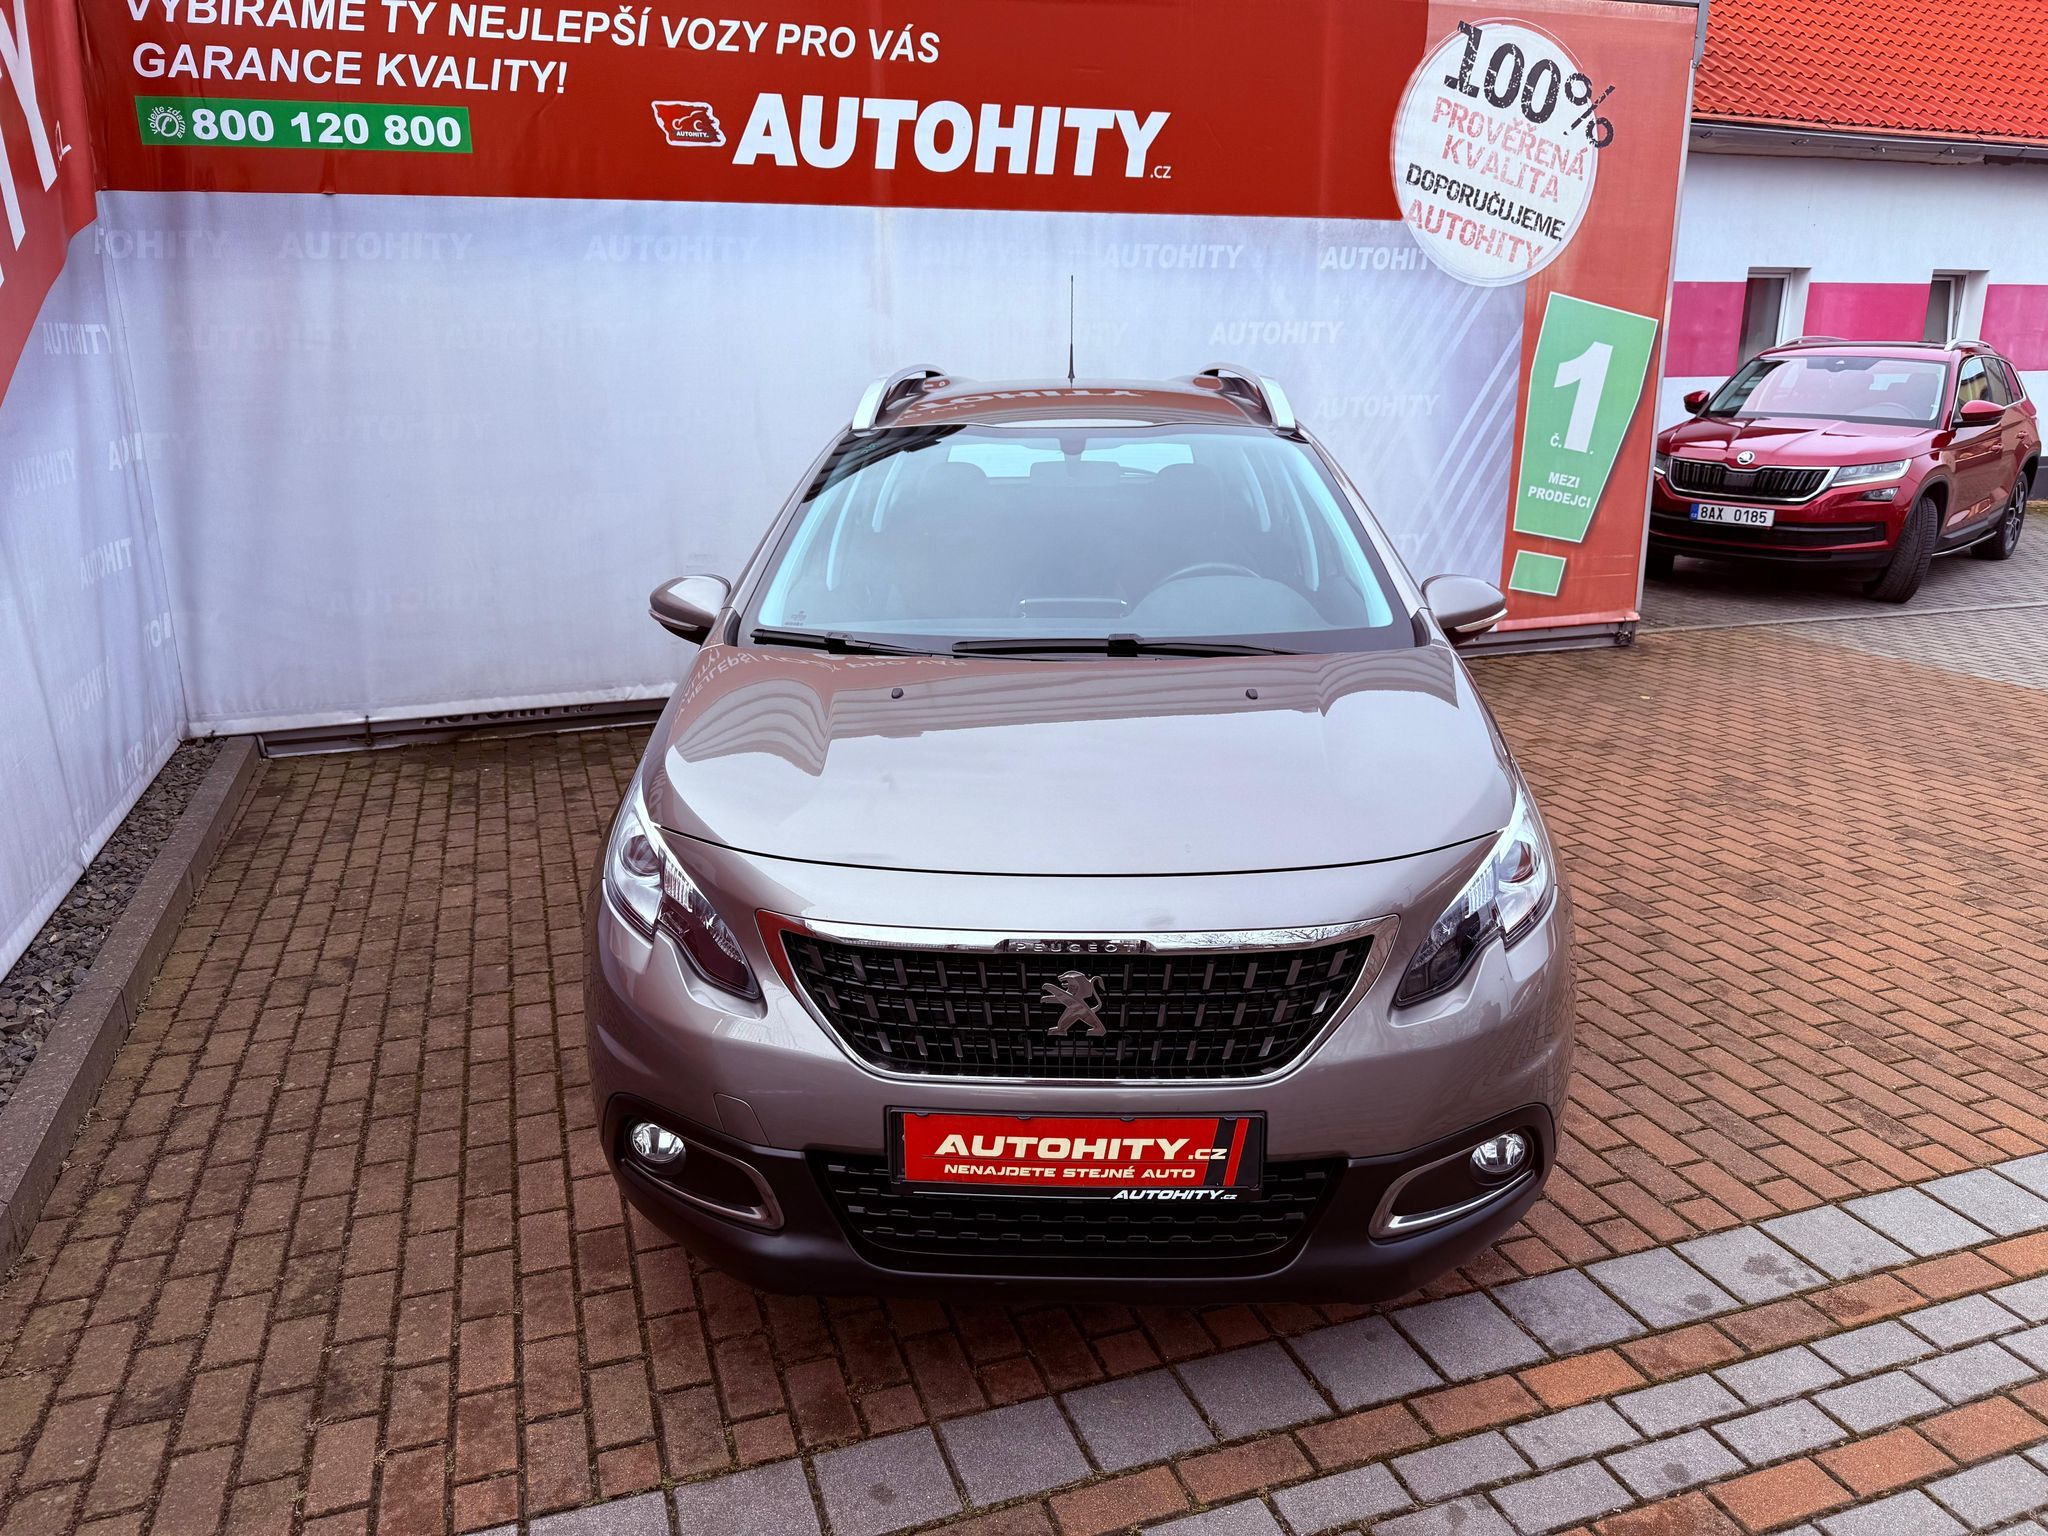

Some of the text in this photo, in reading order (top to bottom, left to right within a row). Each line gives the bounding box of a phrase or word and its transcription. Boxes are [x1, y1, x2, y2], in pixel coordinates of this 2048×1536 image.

[381, 0, 437, 34] TY
[448, 3, 651, 47] NEJLEPŠÍ
[660, 16, 768, 53] VOZY
[776, 23, 856, 58] PRO
[868, 23, 940, 63] VÁS
[132, 42, 567, 93] GARANCE KVALITY!
[1444, 20, 1615, 148] 100%
[191, 108, 462, 147] 800 120 800
[1431, 96, 1588, 181] PROVĚŘENÁ
[1441, 134, 1559, 203] KVALITA
[1405, 163, 1566, 241] DOPORUČUJEME
[277, 231, 474, 261] AUTOHITY
[584, 234, 762, 264] AUTOHITY
[1403, 199, 1544, 269] AUTOHITY
[1102, 243, 1244, 270] AUTOHITY
[1208, 321, 1344, 347] AUTOHITY
[1528, 486, 1591, 508] PRODEJCI
[1548, 471, 1580, 489] MEZI
[1700, 506, 1724, 520] 8AX
[1734, 509, 1767, 523] 0185
[943, 1163, 1196, 1179] NENAJDETE STEJNÉ AUTO
